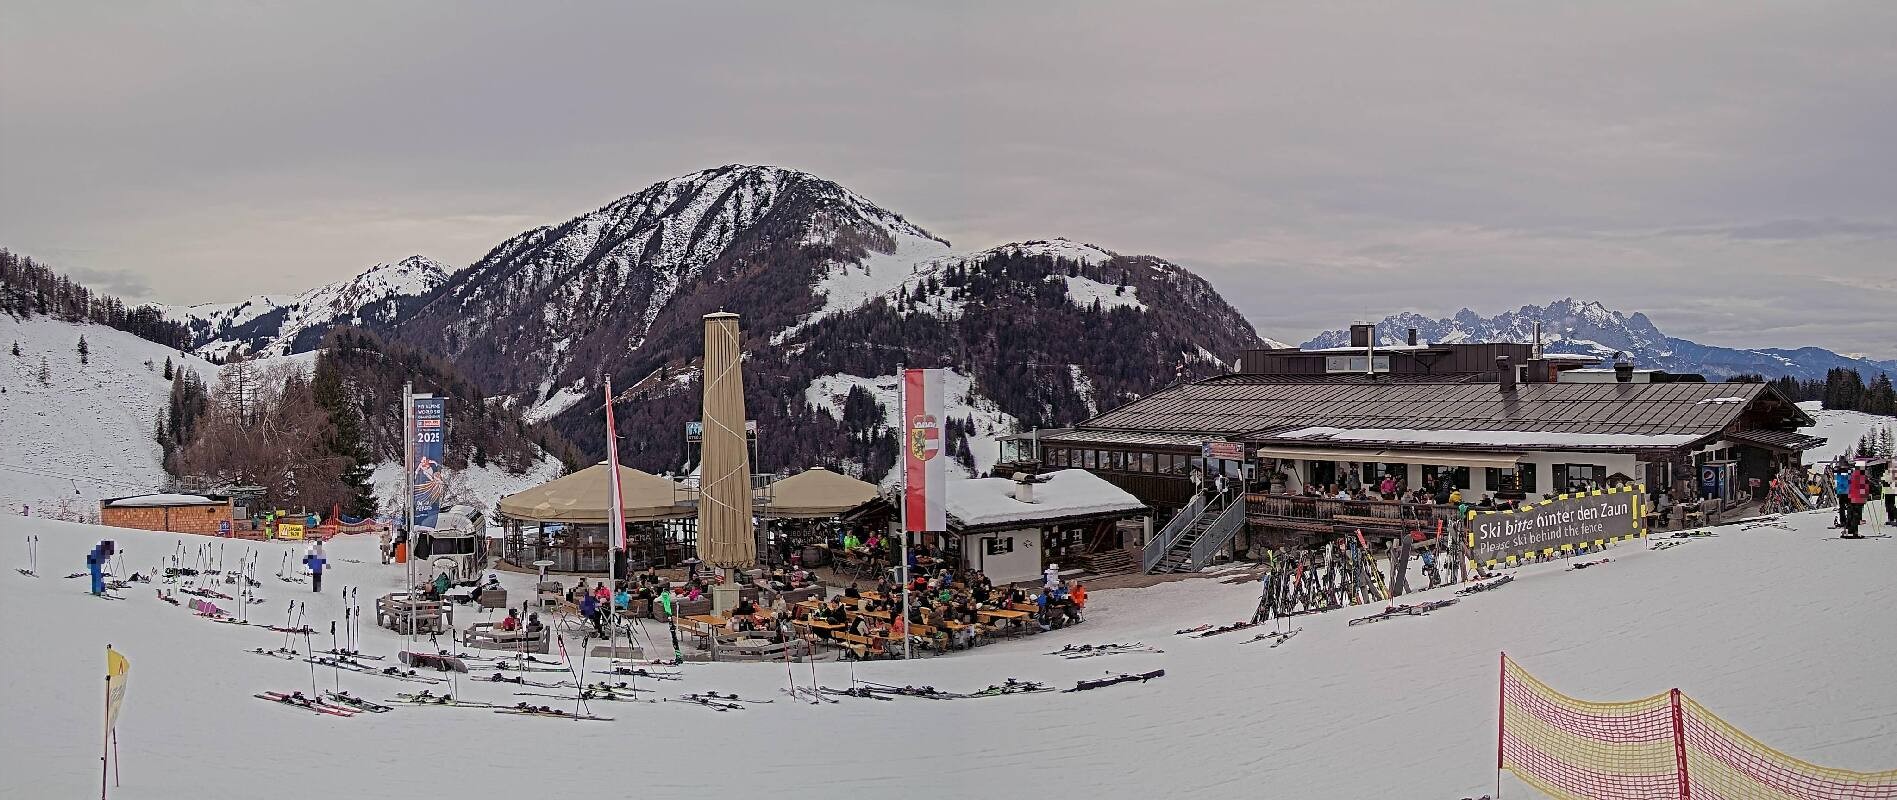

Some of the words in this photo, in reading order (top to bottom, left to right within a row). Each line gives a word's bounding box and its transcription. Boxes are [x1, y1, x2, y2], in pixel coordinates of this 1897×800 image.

[417, 432, 440, 443] 2025
[1480, 521, 1501, 539] Ski
[1505, 519, 1533, 536] bitte
[1536, 510, 1575, 527] hinter
[1577, 505, 1598, 521] den
[1600, 502, 1628, 518] Zaun
[1480, 540, 1510, 554] Please
[1513, 533, 1527, 547] ski
[1529, 526, 1562, 544] behind
[1564, 524, 1579, 537] the
[1581, 522, 1603, 535] fence
